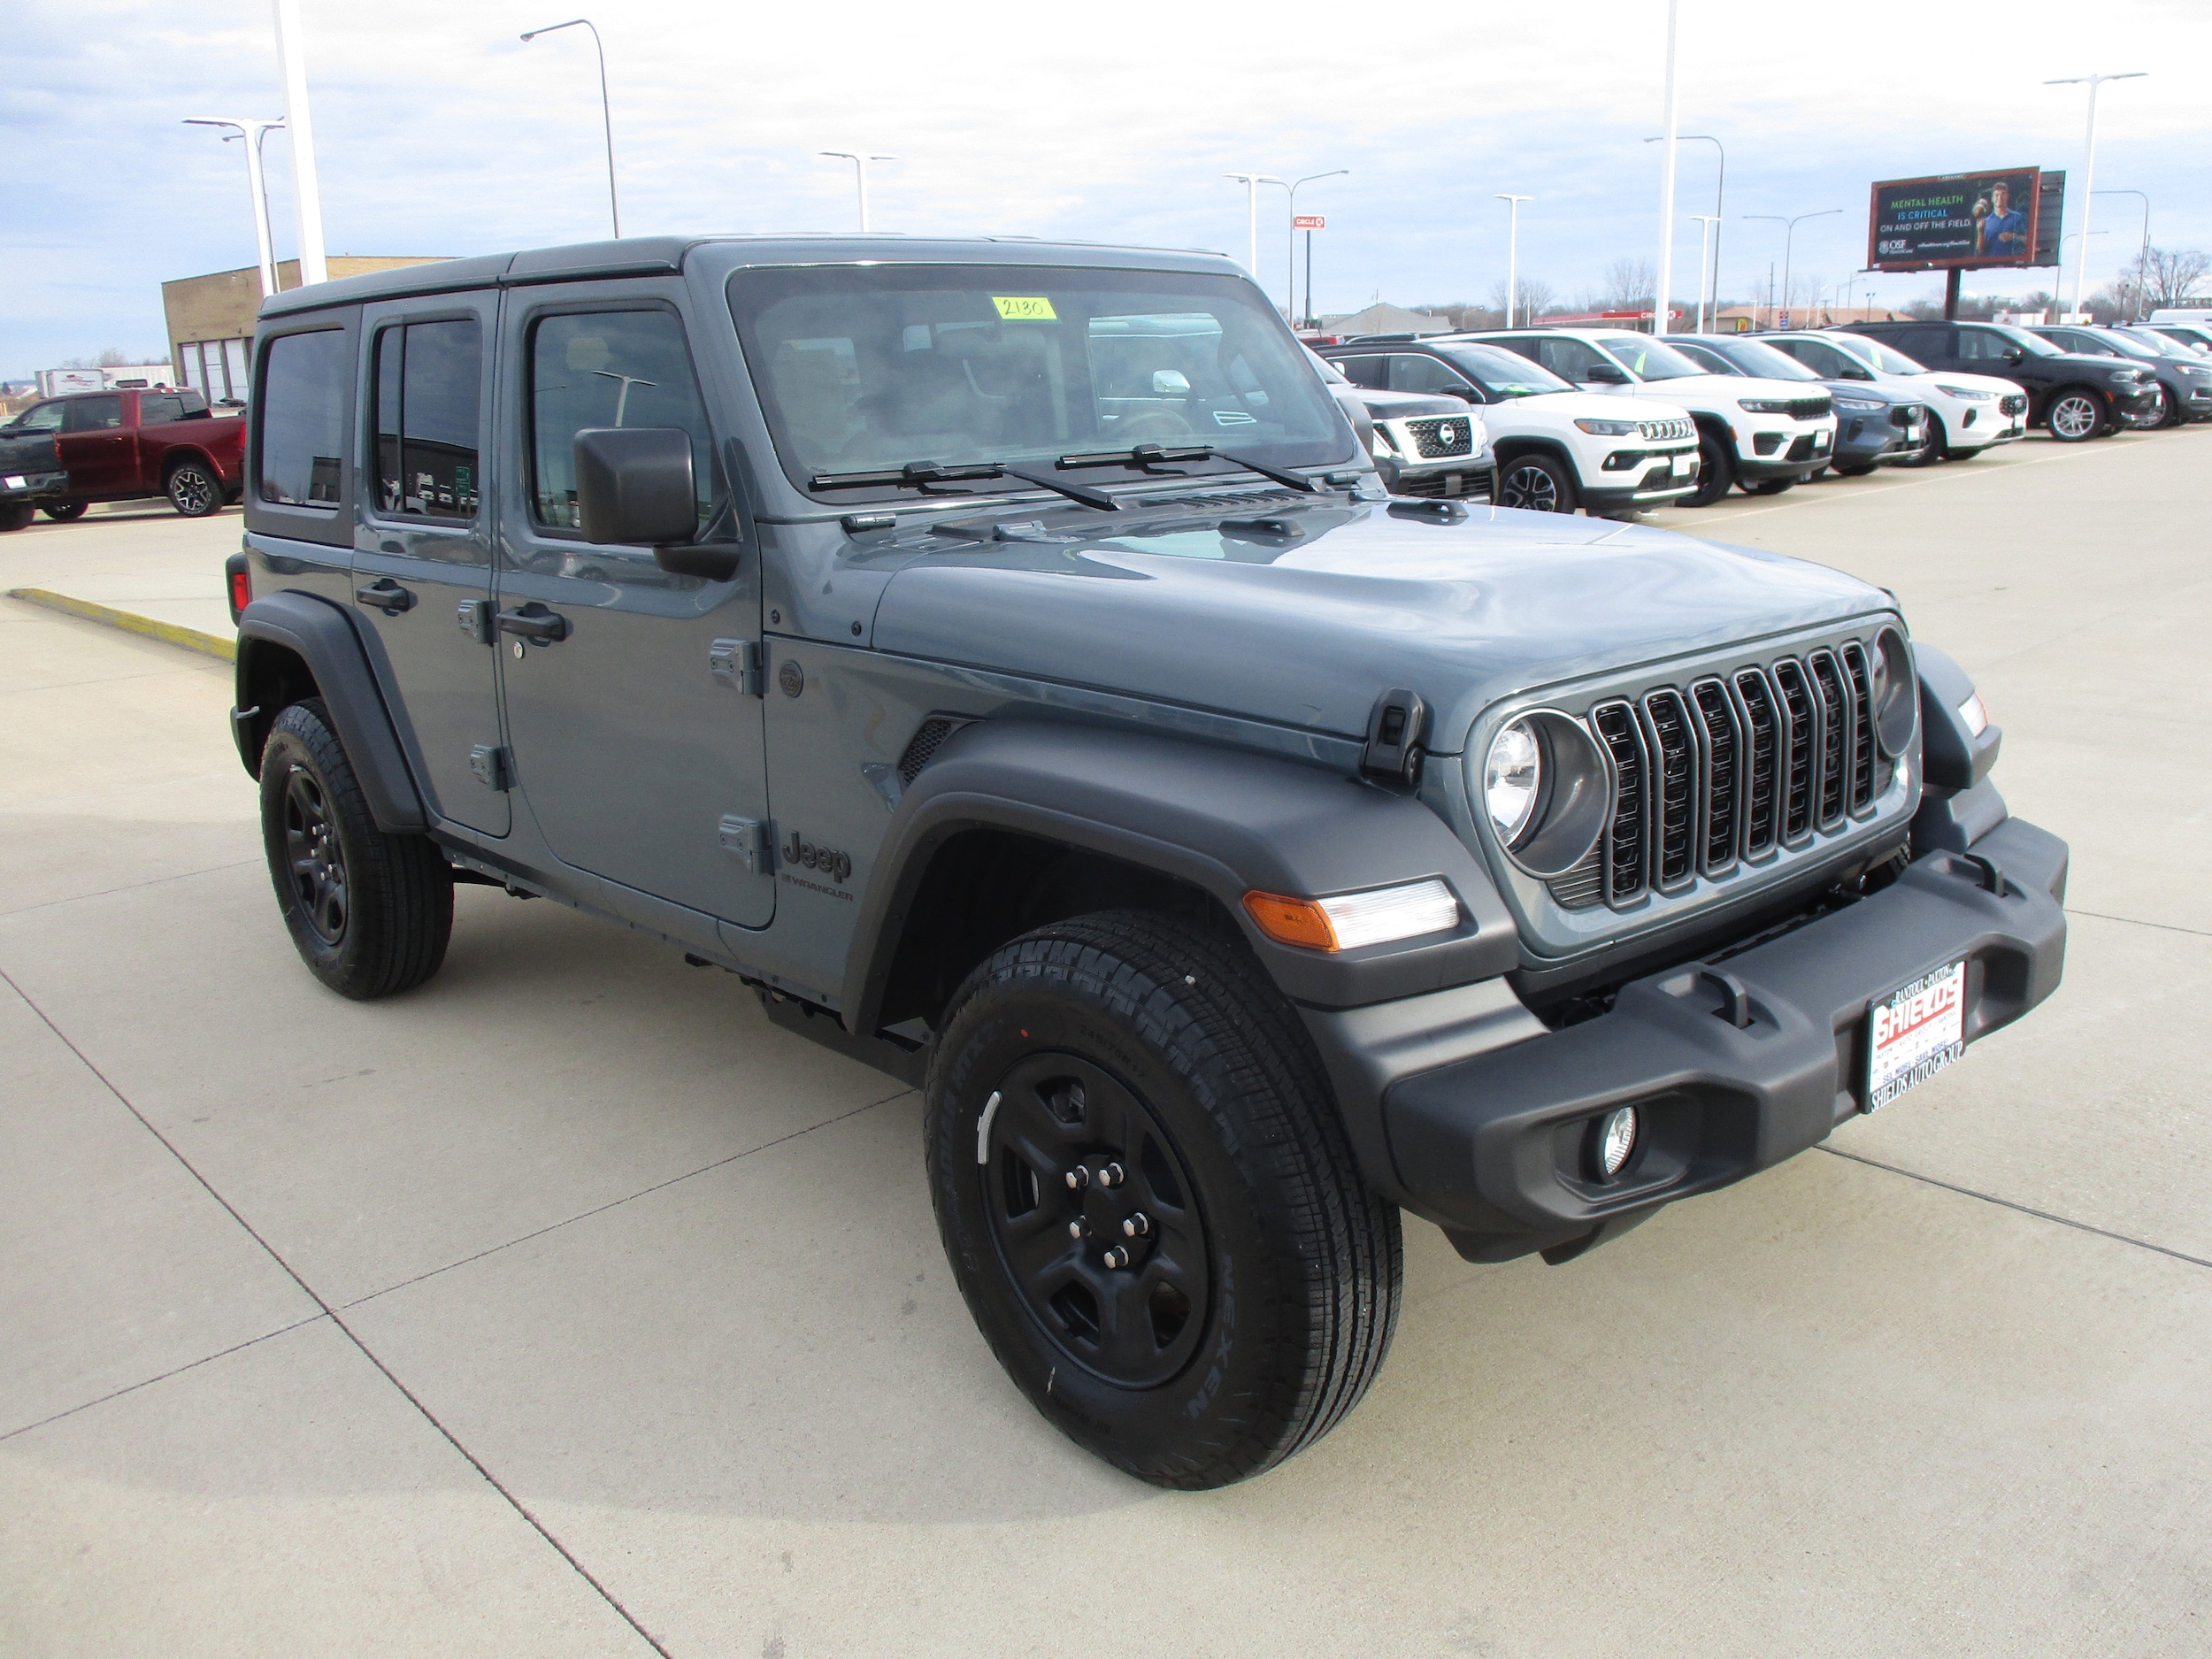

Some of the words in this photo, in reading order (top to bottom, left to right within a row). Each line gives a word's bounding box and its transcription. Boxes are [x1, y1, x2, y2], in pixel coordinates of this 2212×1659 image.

[1891, 199, 1926, 209] MENTAL
[1928, 196, 1963, 205] HEALTH
[1908, 209, 1947, 219] CRITICAL
[1894, 223, 1912, 232] AND
[1913, 221, 1930, 230] OFF
[1931, 220, 1947, 229] THE
[1003, 299, 1043, 315] 2130
[782, 830, 852, 884] Jeep
[791, 876, 854, 902] WRANGLER
[1874, 976, 1959, 1044] SHIELDS
[1871, 1072, 1907, 1113] SHIELDS
[1909, 1057, 1932, 1089] AUTO
[1933, 1039, 1962, 1074] GROUP
[1186, 1251, 1237, 1422] NEXEN
